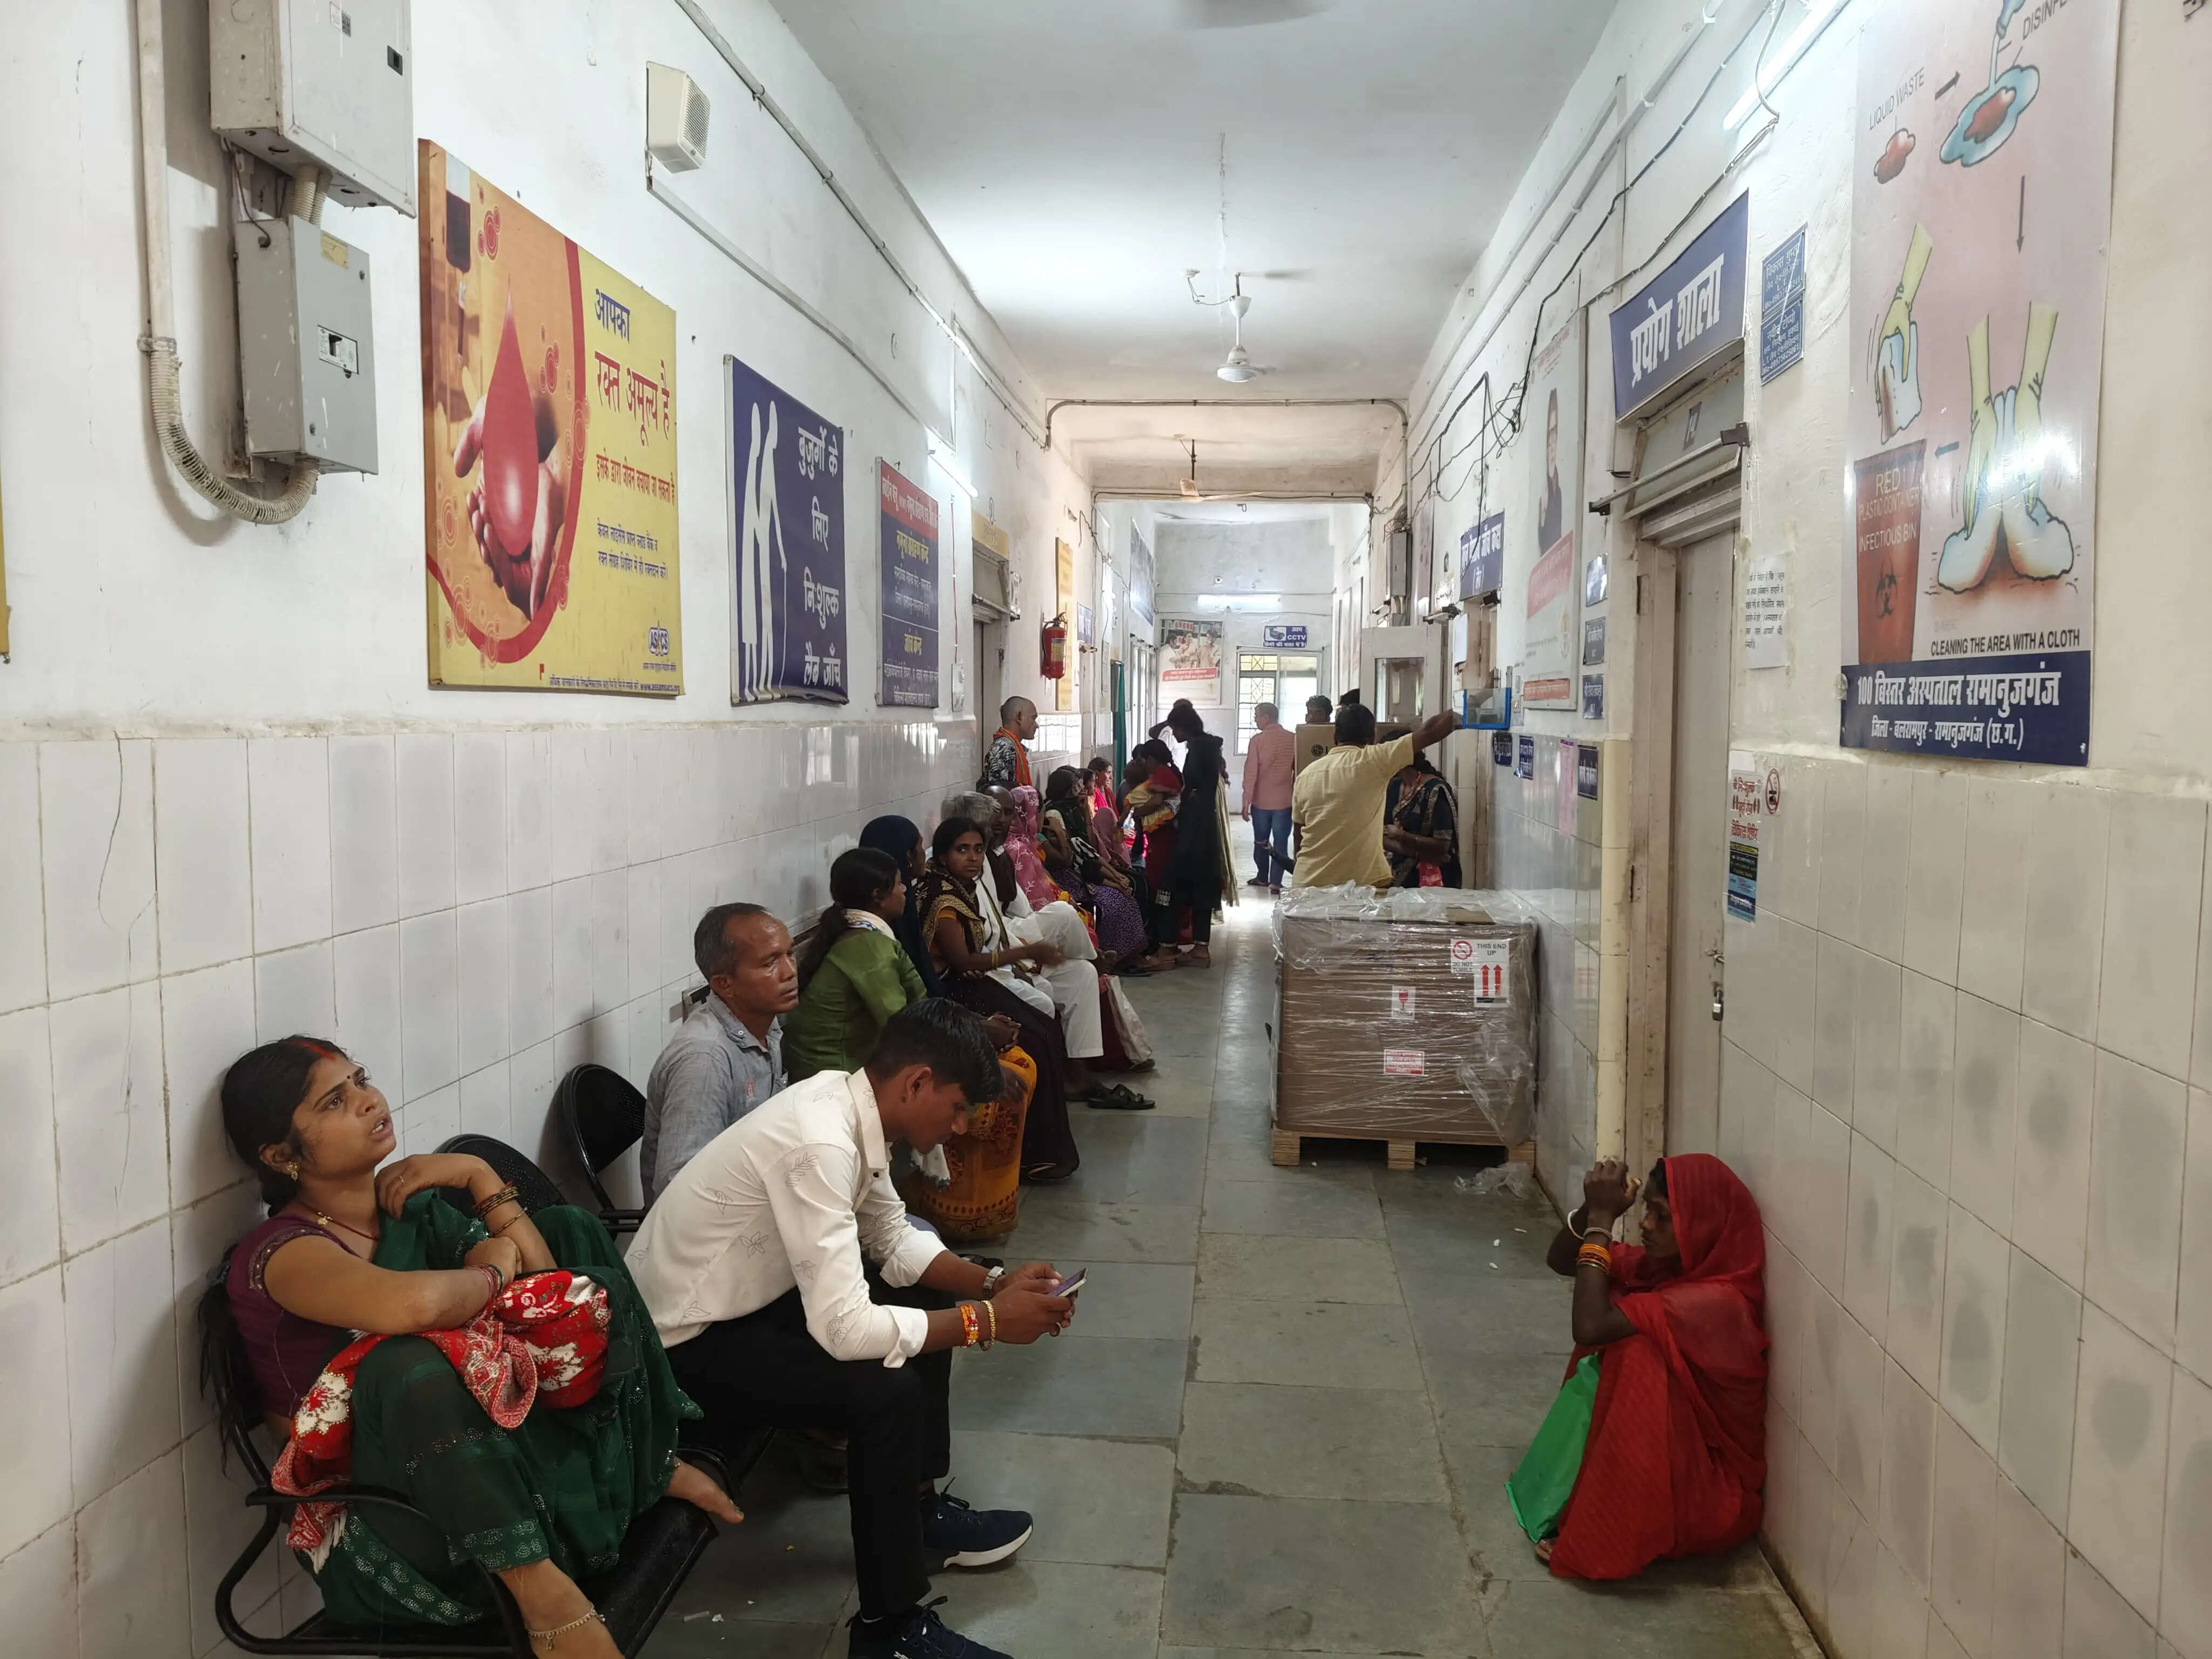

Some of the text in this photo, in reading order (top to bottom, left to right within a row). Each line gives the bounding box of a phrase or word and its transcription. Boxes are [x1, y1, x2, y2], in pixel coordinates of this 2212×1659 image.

[1870, 67, 1924, 130] LIQUID WASTE
[595, 288, 630, 343] आपका
[1630, 253, 1724, 389] प्रयोग शाला
[595, 351, 670, 447] रक्त अमूल्य है
[596, 447, 609, 482] इसके
[610, 460, 621, 485] द्वारा
[622, 456, 635, 490] जीवन
[636, 470, 650, 497] बचाया
[651, 476, 657, 497] जा
[658, 478, 670, 503] सकता
[798, 426, 838, 480] बुजुर्गों के
[1876, 468, 1901, 496] RED
[812, 496, 828, 552] लिए
[1859, 498, 1882, 521] PLASTIC
[1859, 523, 1917, 552] INFECTIOUS BIN
[804, 641, 820, 686] लैब
[1931, 629, 2080, 656] CLEANING THE AREA WITH A CLOTH
[1858, 661, 2061, 718] 100 बिस्तर अस्पताल रामानुजगंज
[1871, 715, 1889, 738] जिला
[1894, 720, 1928, 746] बलरामपुर
[1935, 717, 1985, 748] रामानुजगंज
[1986, 717, 2024, 751] (छ.ग.)
